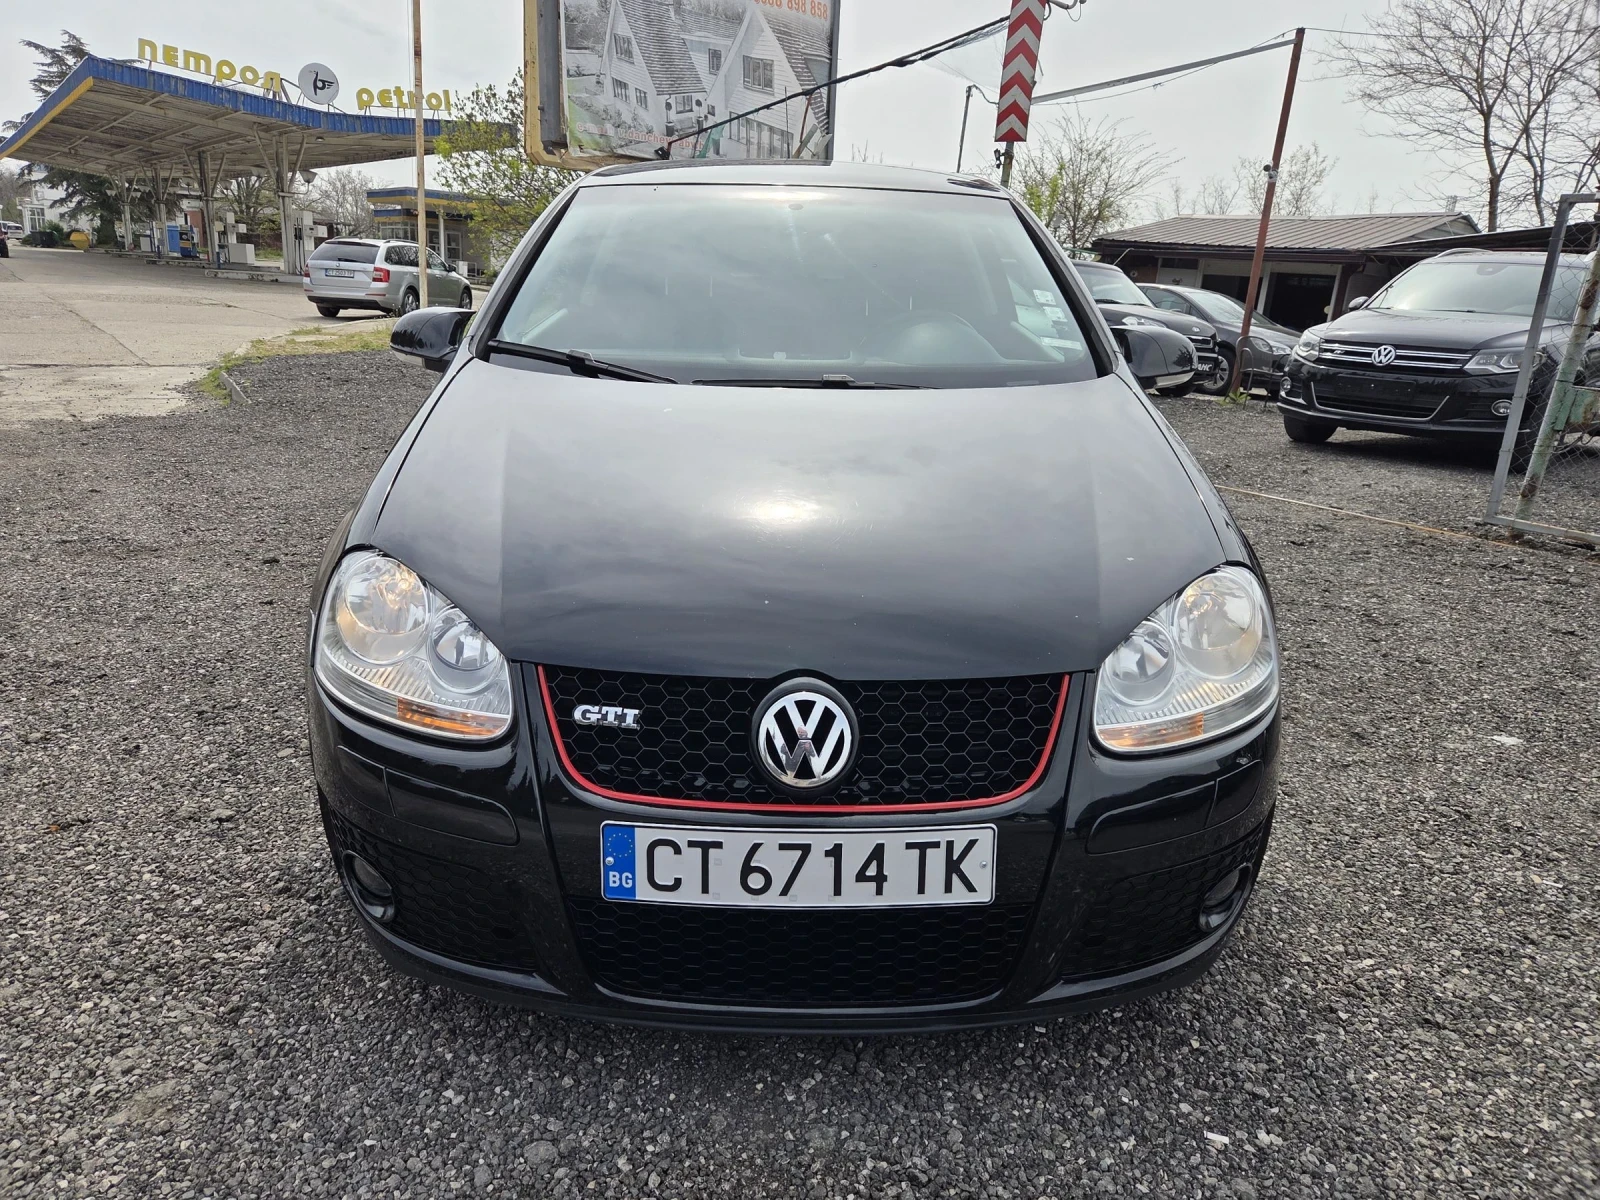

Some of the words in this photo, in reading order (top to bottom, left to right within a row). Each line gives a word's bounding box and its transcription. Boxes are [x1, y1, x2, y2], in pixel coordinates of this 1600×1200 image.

[810, 0, 828, 20] 858
[356, 86, 451, 112] petrol
[573, 705, 640, 729] GTI
[759, 691, 852, 788] VW
[608, 870, 633, 889] BG
[739, 842, 888, 897] 6714
